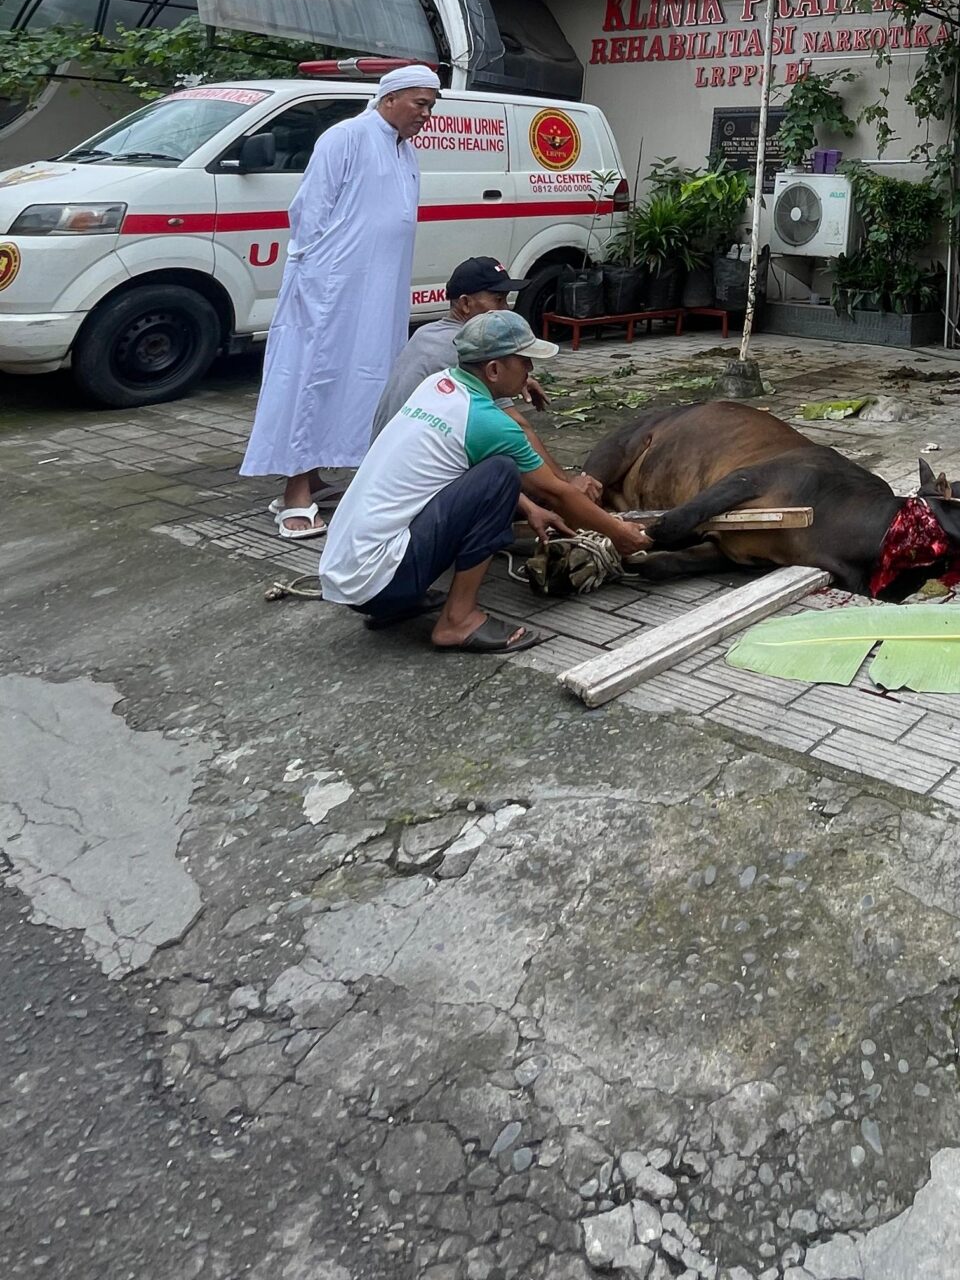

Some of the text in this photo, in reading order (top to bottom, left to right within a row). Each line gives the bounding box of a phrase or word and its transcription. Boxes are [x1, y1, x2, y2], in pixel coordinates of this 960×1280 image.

[589, 23, 951, 65] REHABILITASI NARKOTIKA
[475, 118, 505, 136] URINE
[459, 137, 504, 152] HEALING
[529, 173, 592, 184] CALL CENTRE
[532, 185, 552, 193] 0812
[410, 407, 453, 437] Banget
